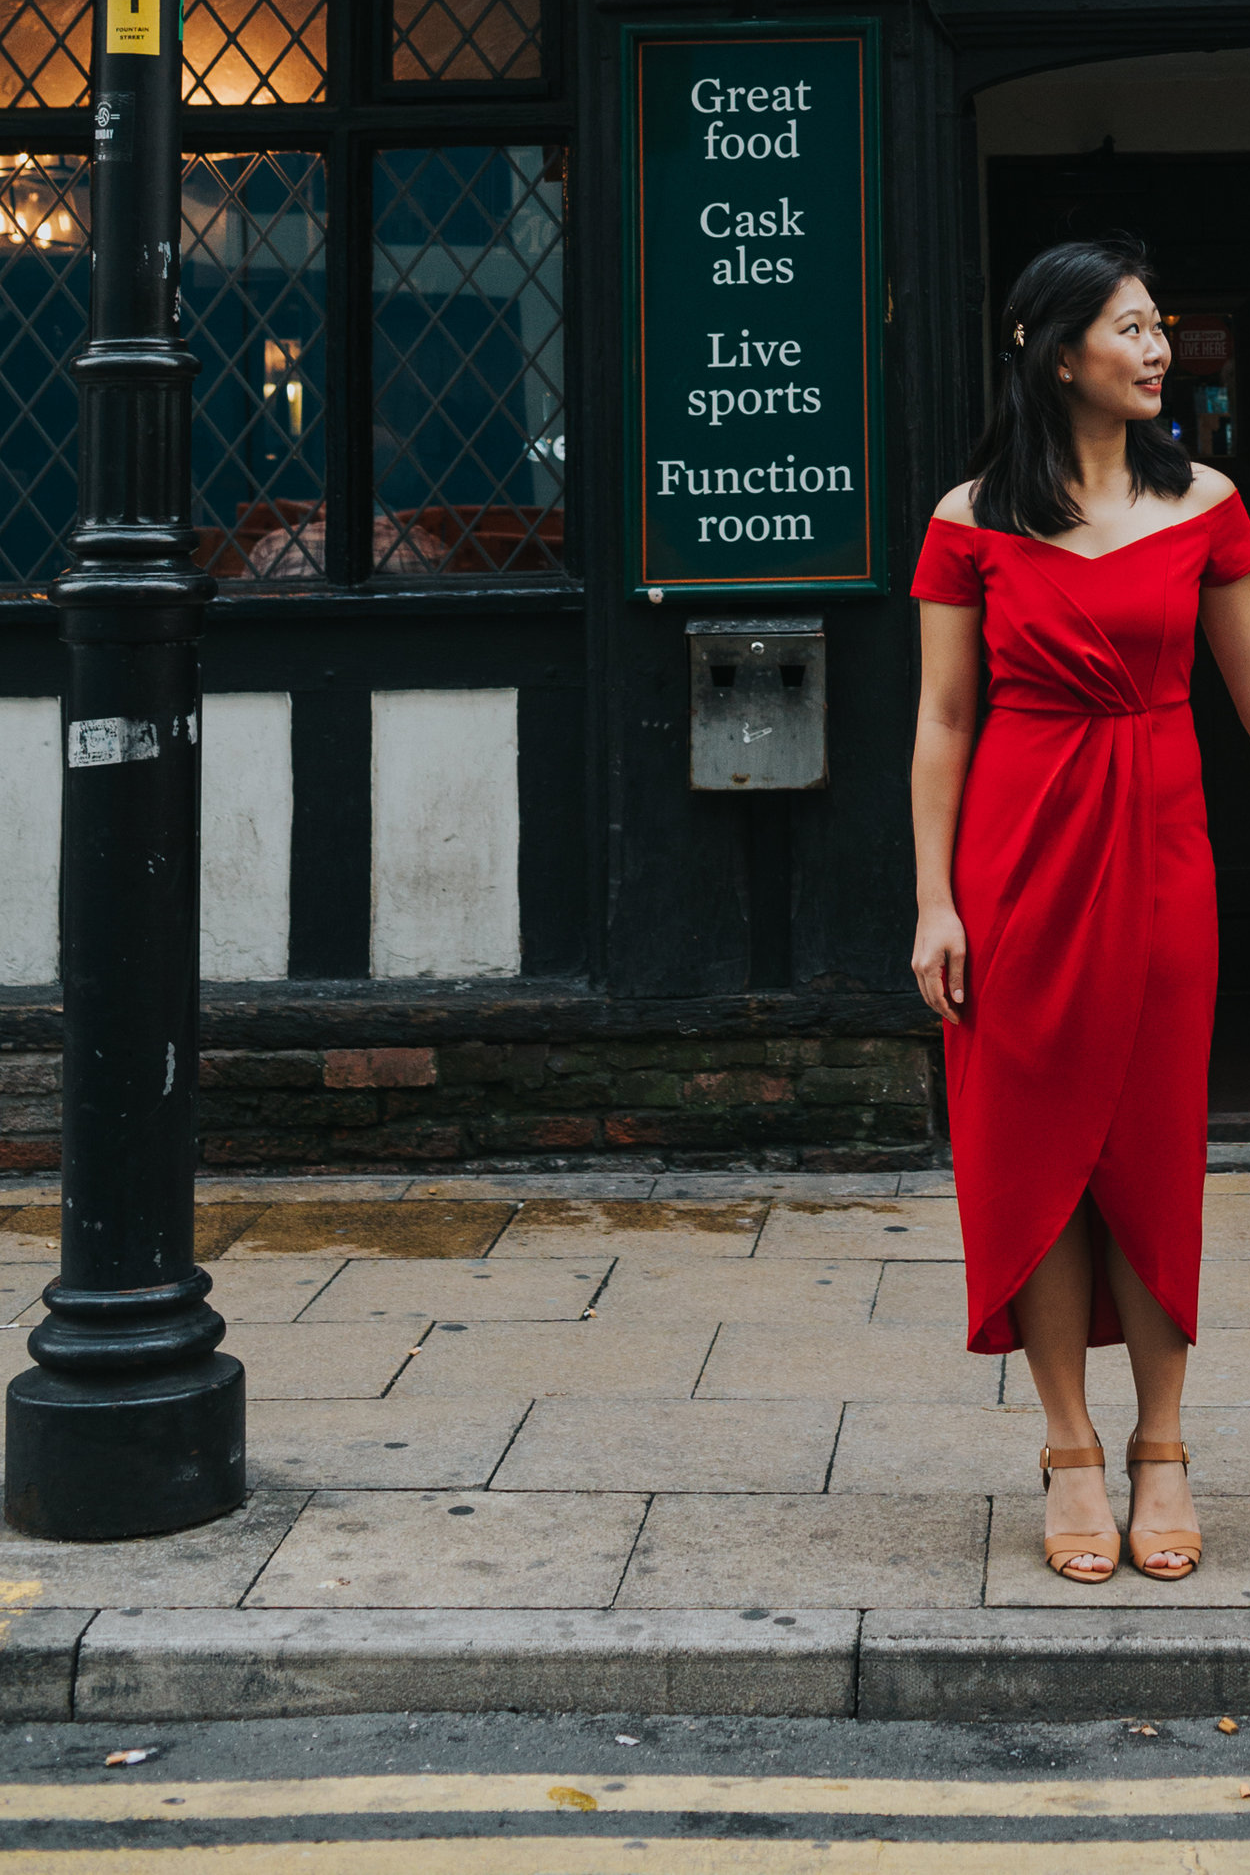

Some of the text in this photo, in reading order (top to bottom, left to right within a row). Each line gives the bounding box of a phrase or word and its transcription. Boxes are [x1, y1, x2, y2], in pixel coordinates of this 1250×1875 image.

[691, 78, 812, 114] Great
[704, 119, 800, 160] food
[700, 197, 805, 238] Cask
[712, 245, 794, 285] ales
[707, 329, 802, 368] Live
[1180, 341, 1227, 356] LIVE HERE
[688, 382, 822, 426] sports
[657, 454, 854, 496] Function
[698, 513, 815, 543] room
